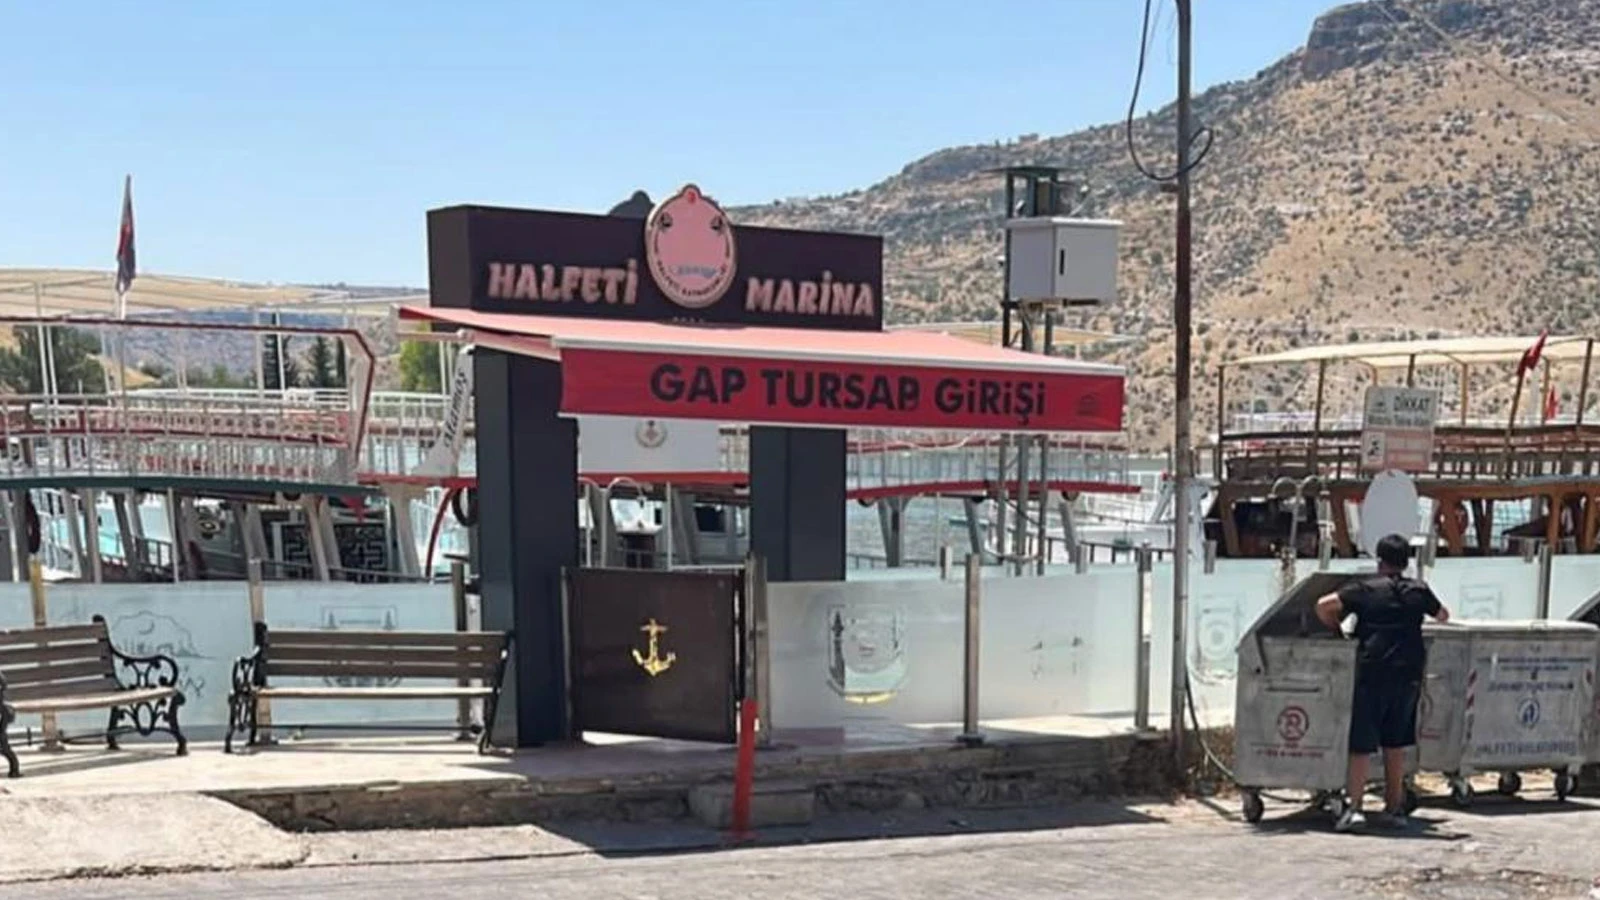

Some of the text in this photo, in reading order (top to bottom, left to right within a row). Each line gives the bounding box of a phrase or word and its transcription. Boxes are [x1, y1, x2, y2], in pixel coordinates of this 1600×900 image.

[487, 258, 639, 304] HALFETİ
[745, 269, 874, 316] MARİNA
[650, 363, 747, 404] GAP
